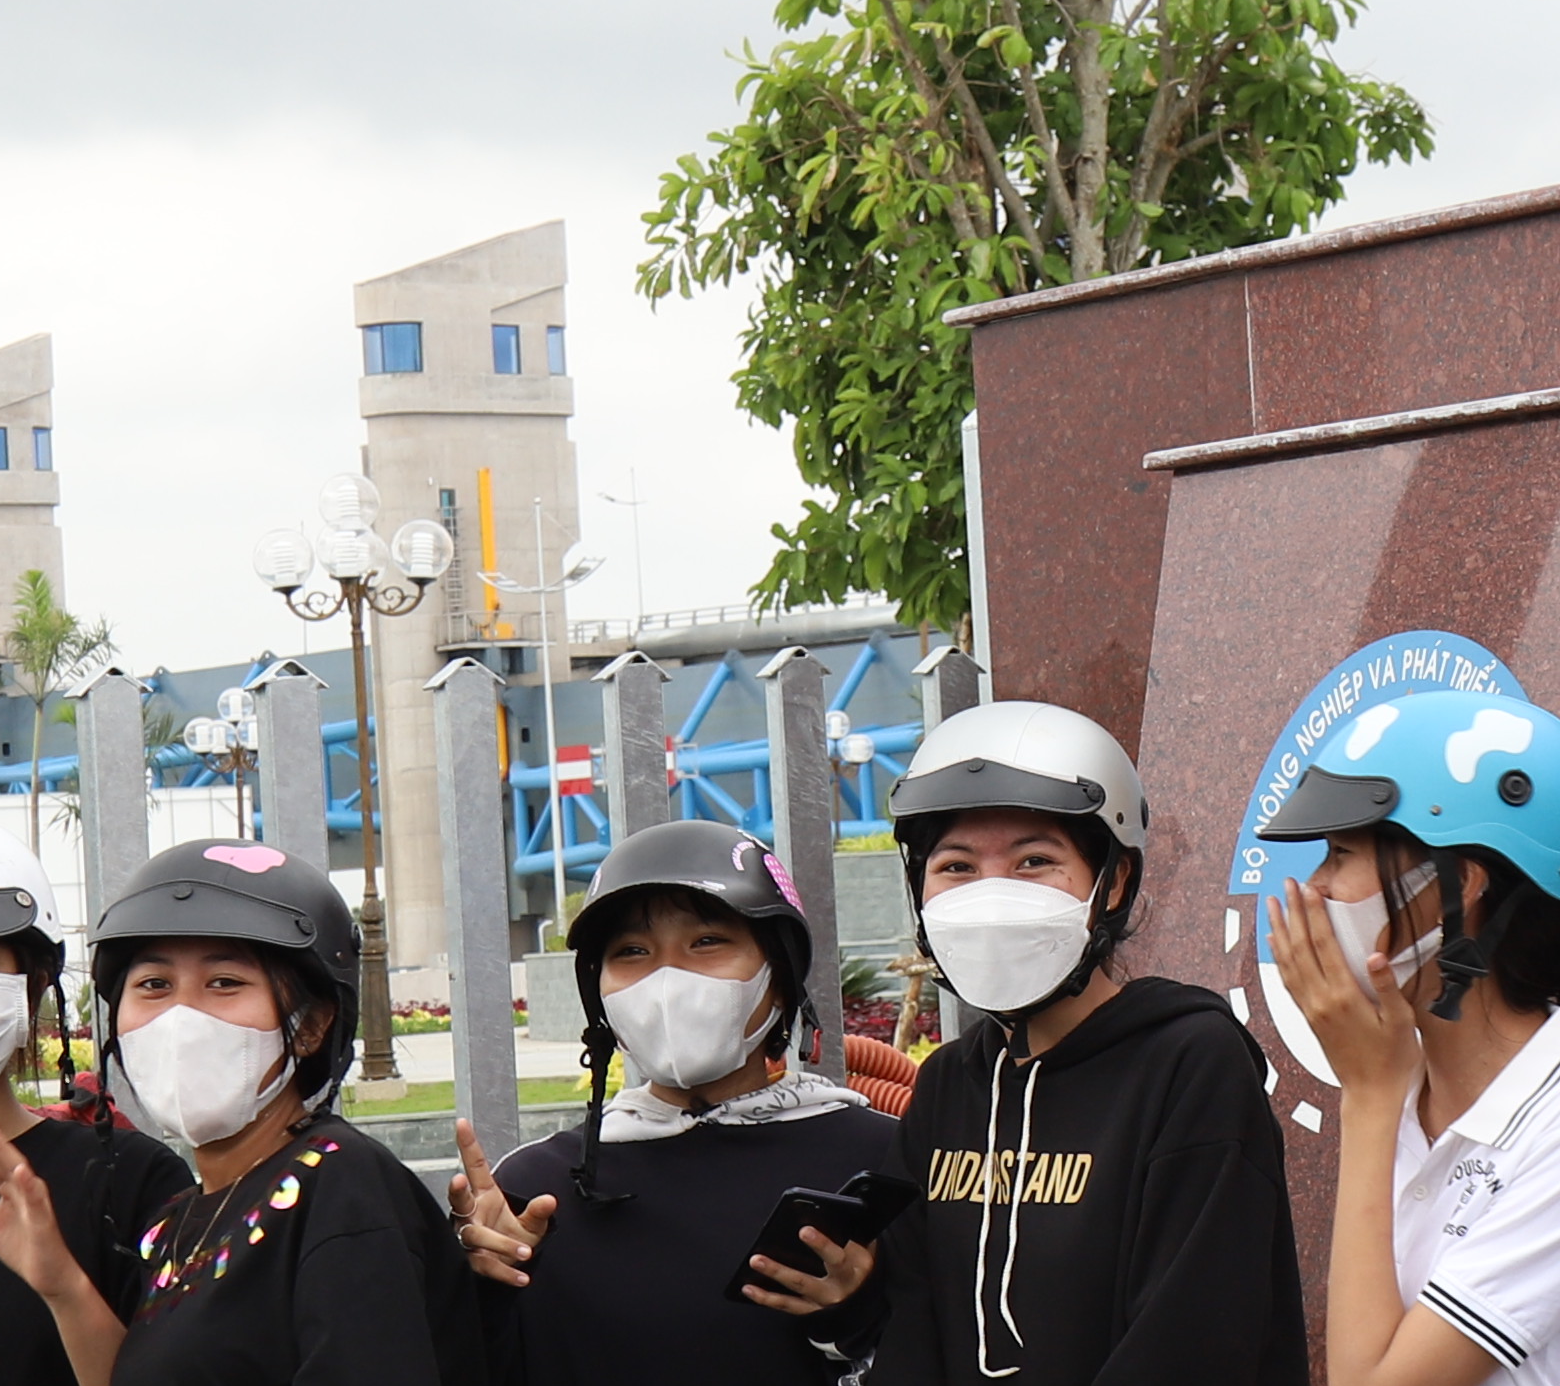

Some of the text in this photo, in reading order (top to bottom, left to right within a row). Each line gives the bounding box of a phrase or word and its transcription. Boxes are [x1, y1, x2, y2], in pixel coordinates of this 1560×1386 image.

[1241, 846, 1270, 884] BỘ
[1295, 671, 1363, 756] NGHIỆP
[1368, 644, 1396, 690] VÀ
[1401, 640, 1451, 682] PHÁT
